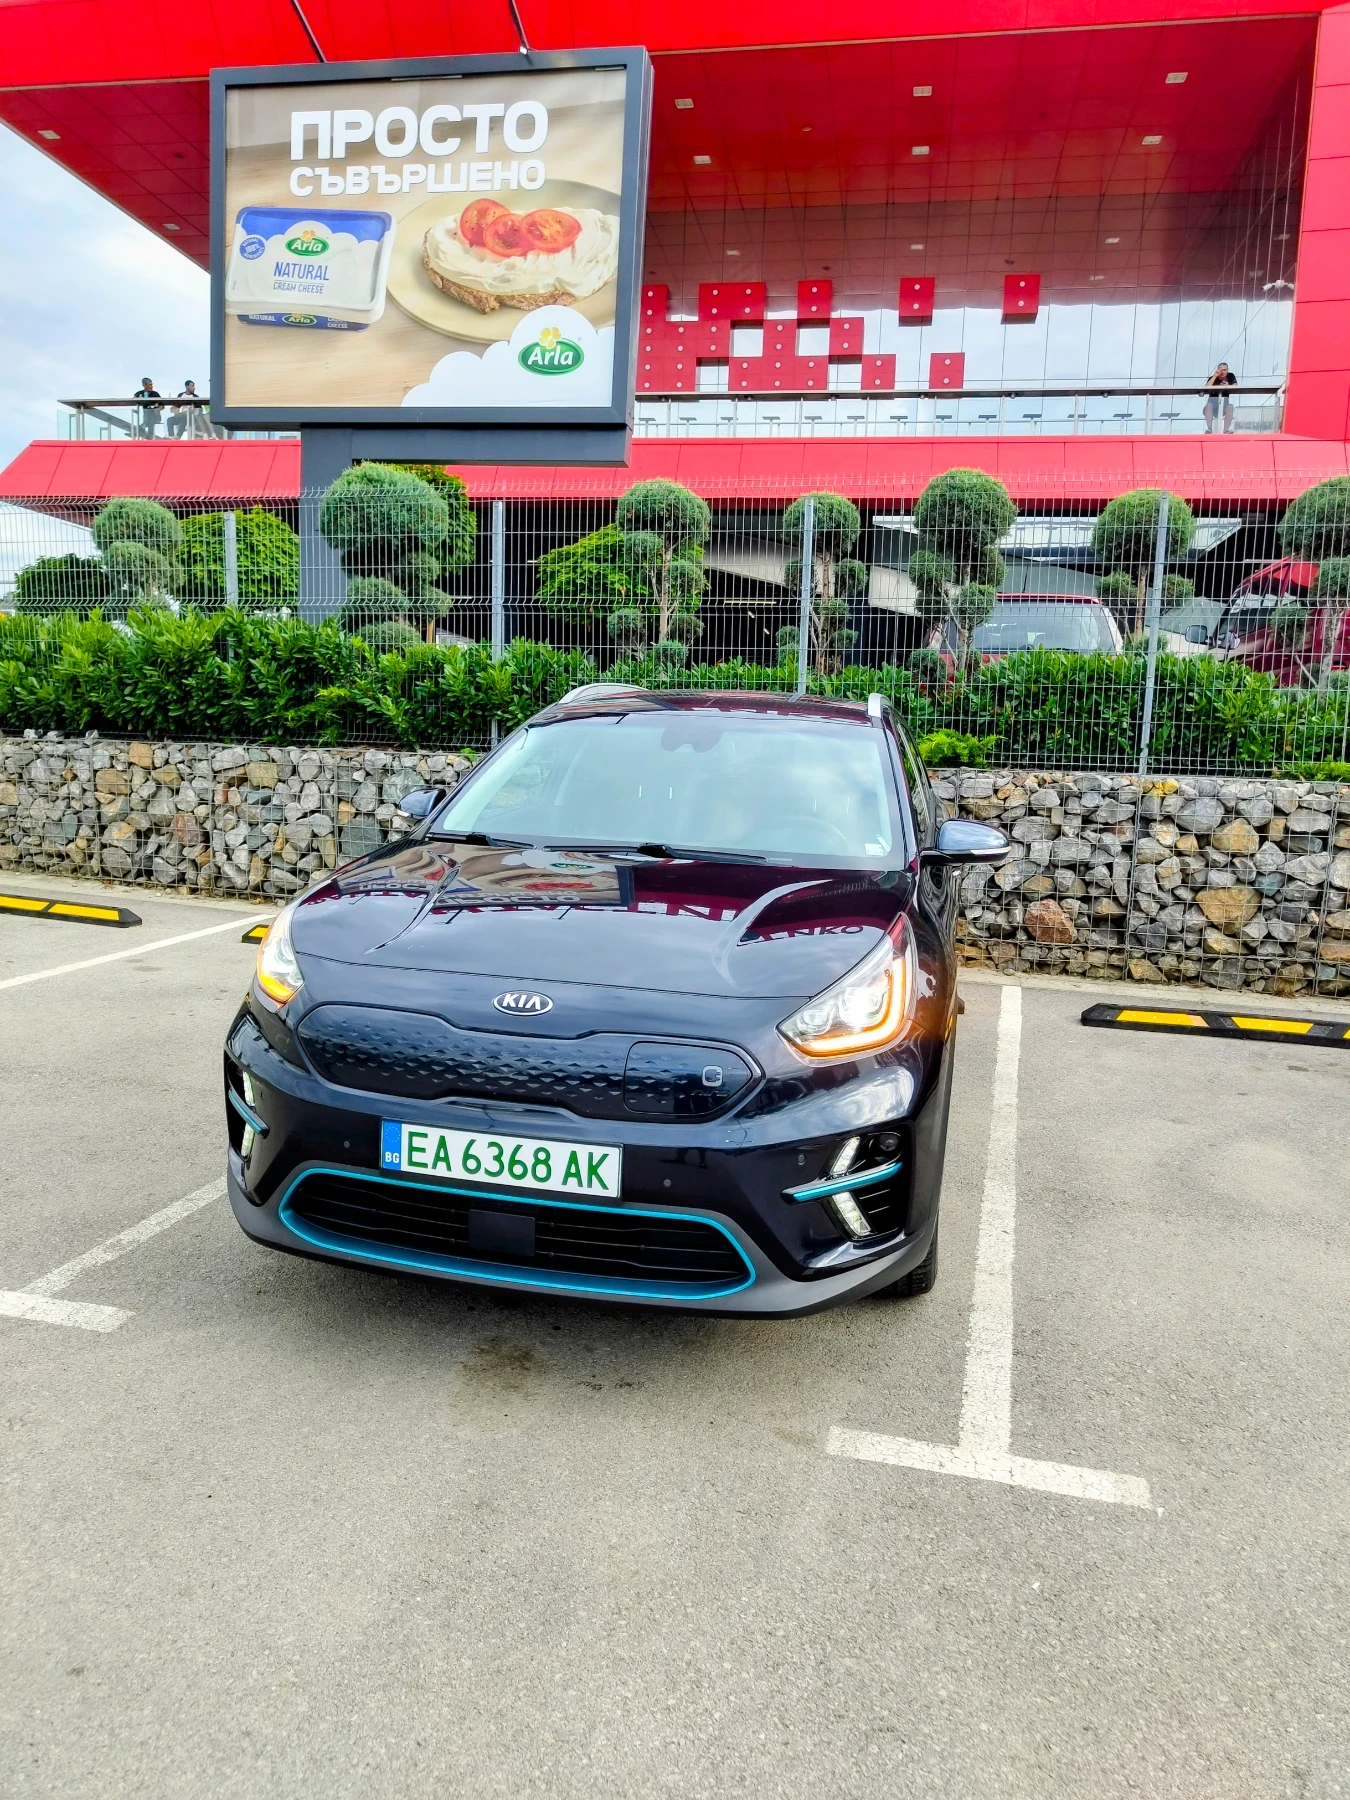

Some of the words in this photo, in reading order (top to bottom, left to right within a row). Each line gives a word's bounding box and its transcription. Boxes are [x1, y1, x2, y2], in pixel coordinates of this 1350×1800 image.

[290, 100, 549, 161] ПРОСТО
[289, 159, 546, 197] СЪВЪРШЕНО
[291, 238, 322, 252] Arla
[273, 261, 330, 281] NATURAL
[273, 282, 296, 292] CREAM
[297, 283, 325, 294] CHEESE
[249, 314, 277, 322] NATURAL
[527, 345, 574, 365] Arla
[501, 993, 541, 1011] KIA
[384, 1151, 400, 1163] BG
[407, 1130, 453, 1172] EA
[461, 1138, 552, 1183] 6368
[561, 1150, 610, 1191] AK
